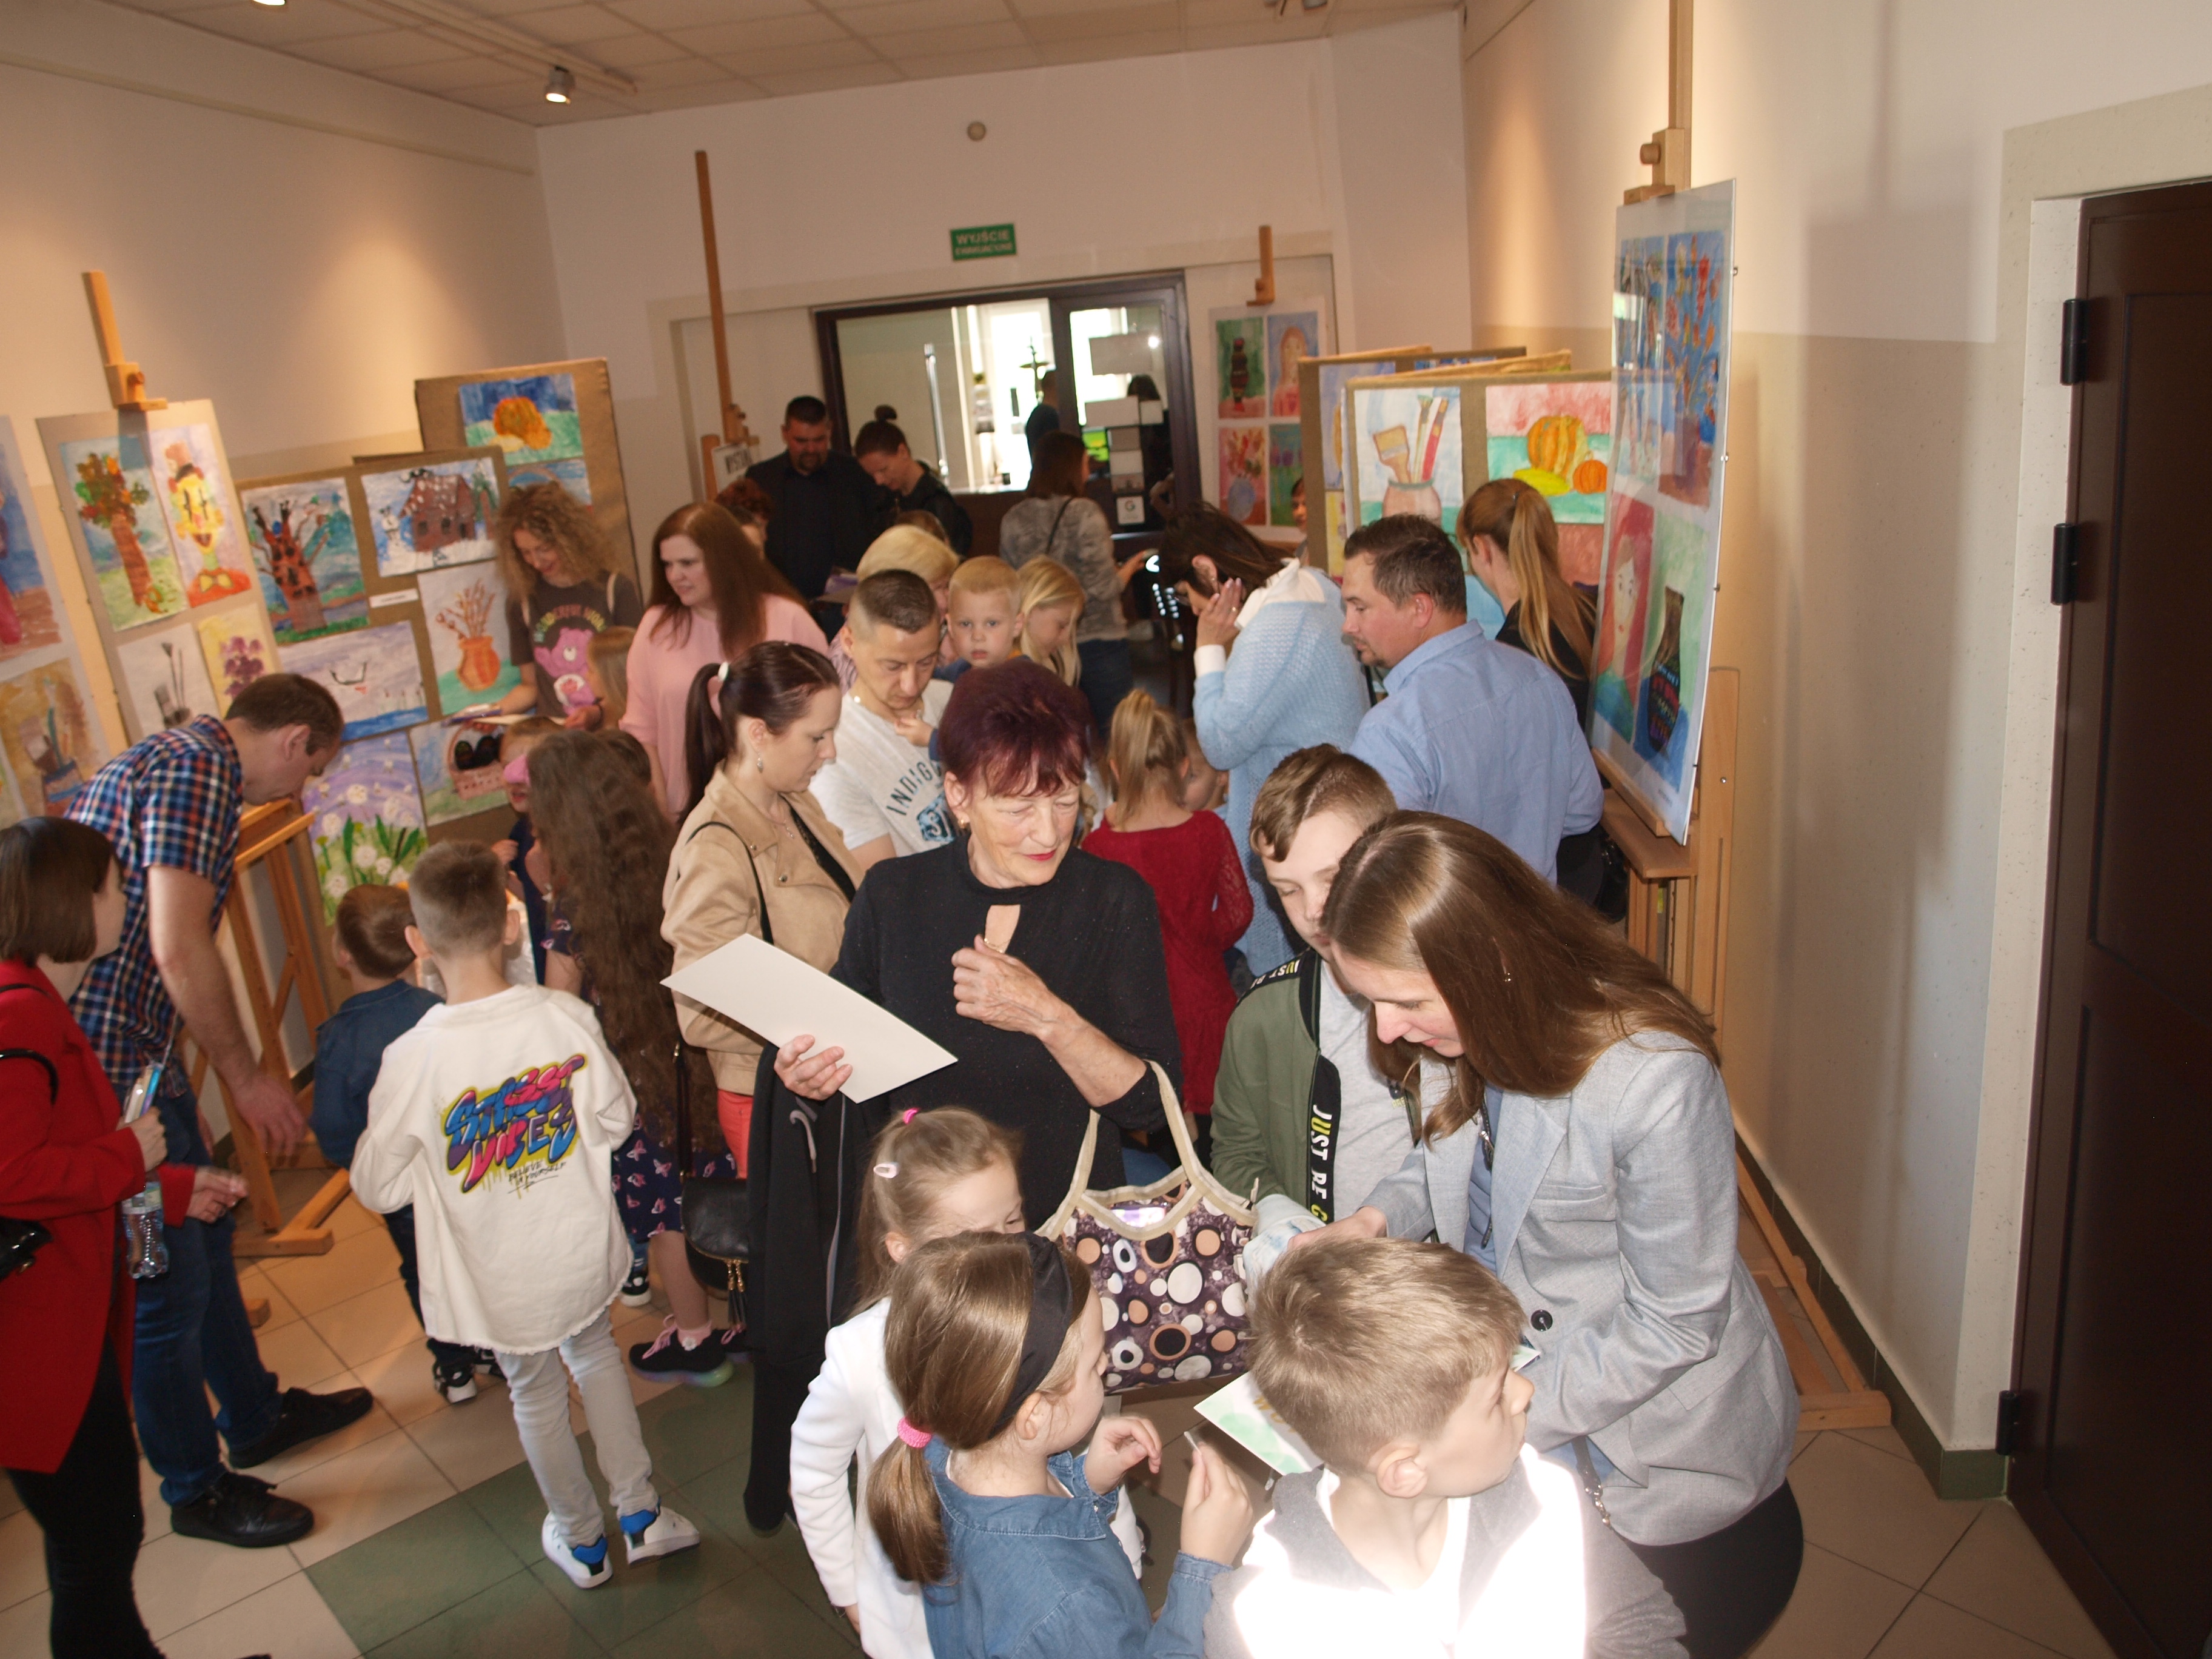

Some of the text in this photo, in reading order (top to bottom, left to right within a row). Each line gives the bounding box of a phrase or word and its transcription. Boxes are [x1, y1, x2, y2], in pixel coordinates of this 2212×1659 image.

[1310, 1104, 1332, 1161] JUST
[509, 1159, 543, 1182] BELIEVE
[525, 1162, 566, 1185] YOURSELF
